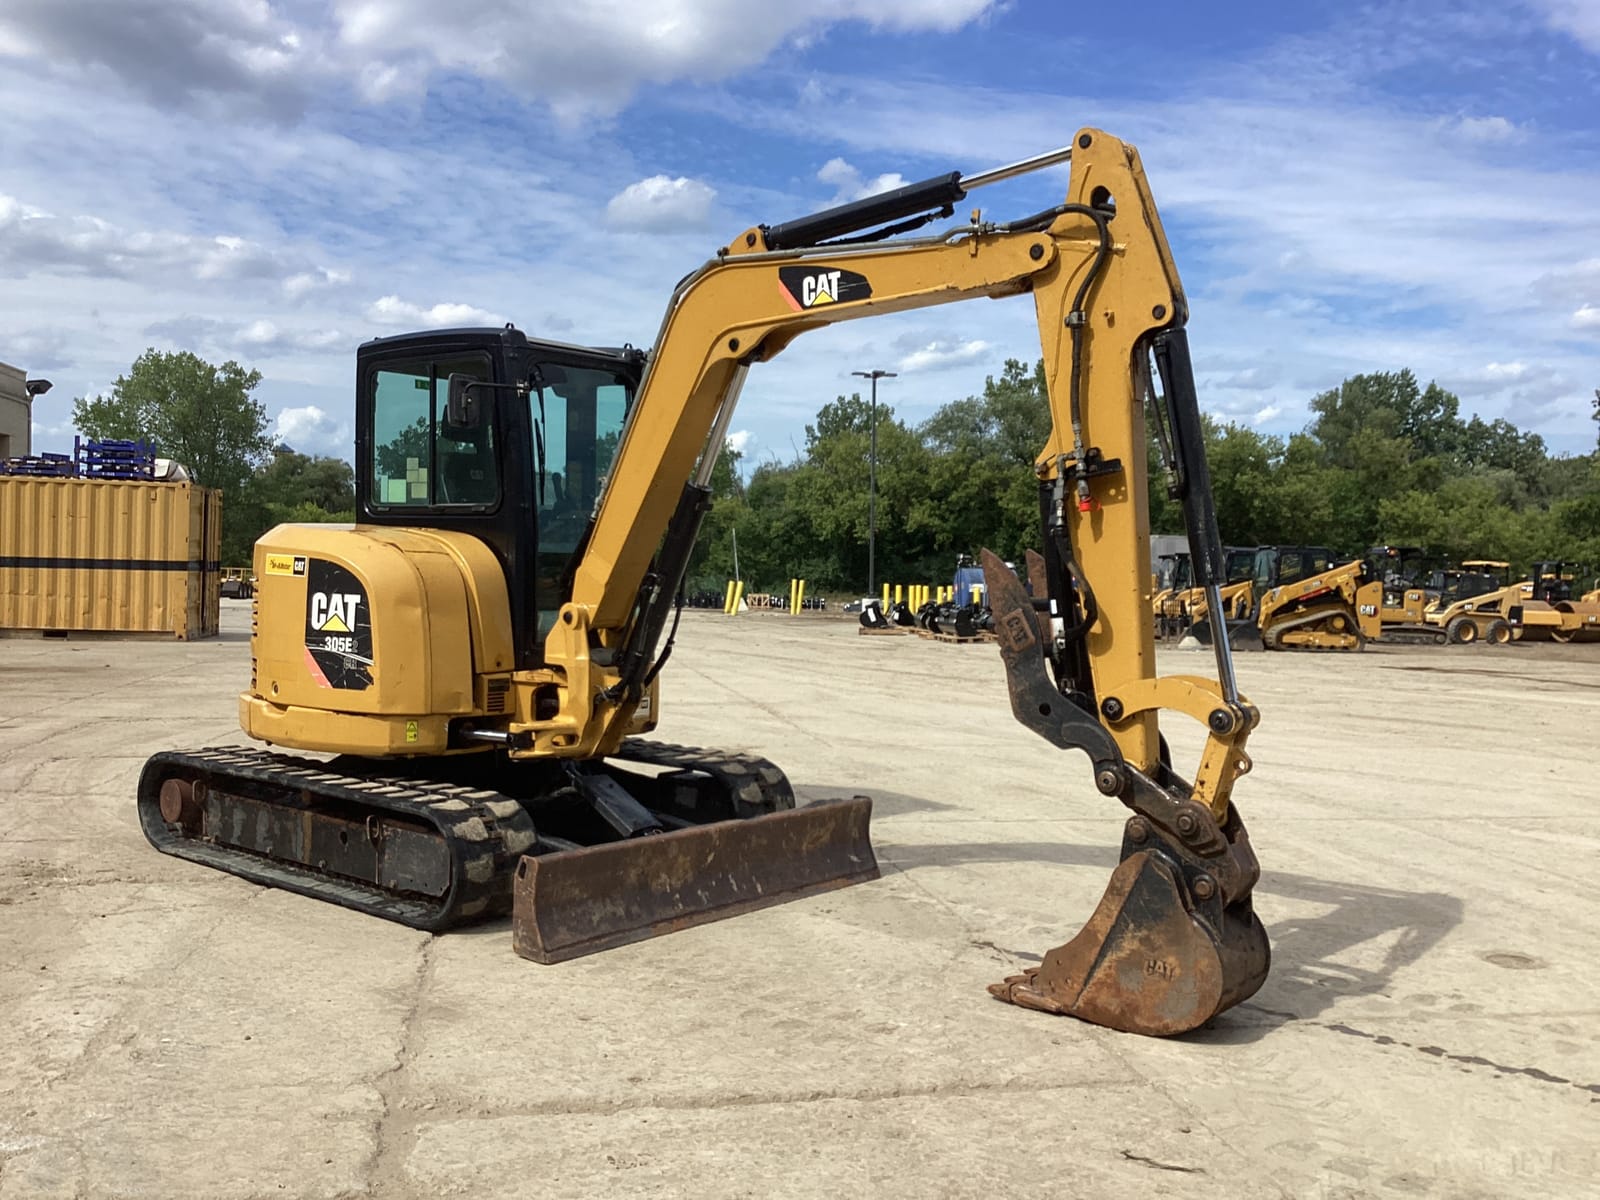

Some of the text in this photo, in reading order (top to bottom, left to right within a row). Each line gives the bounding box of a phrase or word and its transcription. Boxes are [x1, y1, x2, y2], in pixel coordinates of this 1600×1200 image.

[802, 271, 841, 307] CAT
[311, 592, 361, 633] CAT
[1360, 604, 1376, 615] CAT
